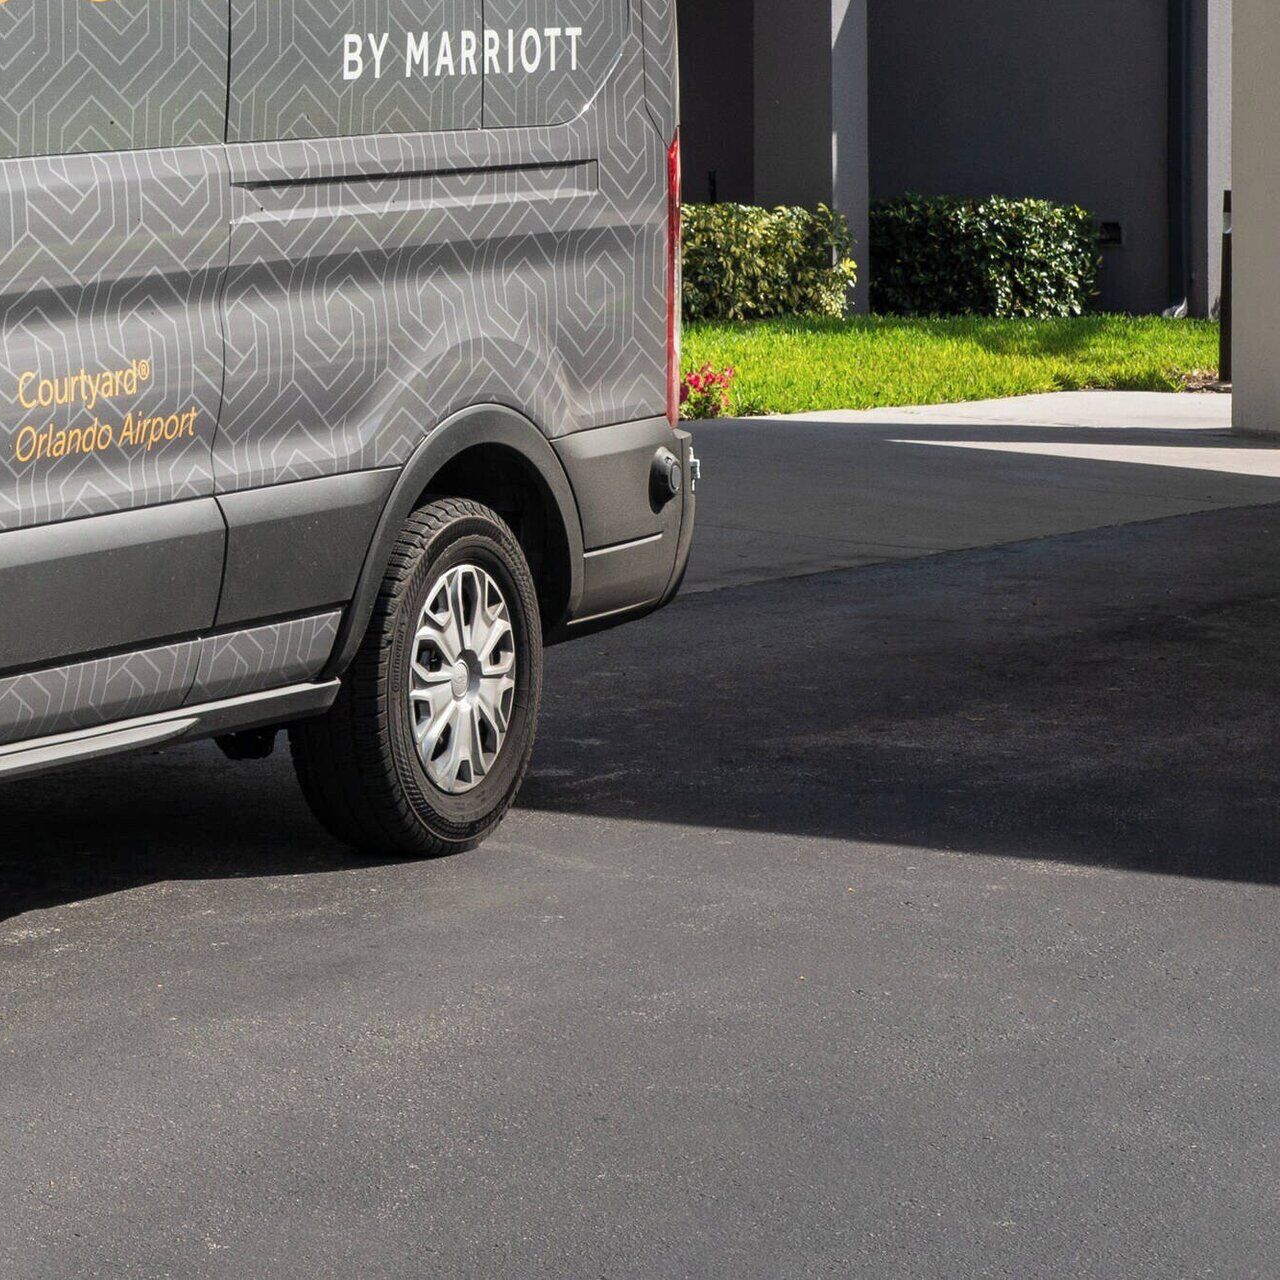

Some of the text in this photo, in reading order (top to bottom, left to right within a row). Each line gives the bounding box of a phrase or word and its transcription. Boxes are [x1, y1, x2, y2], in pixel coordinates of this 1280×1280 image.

[343, 27, 583, 80] BY MARRIOTT
[16, 406, 197, 462] Orlando Airport
